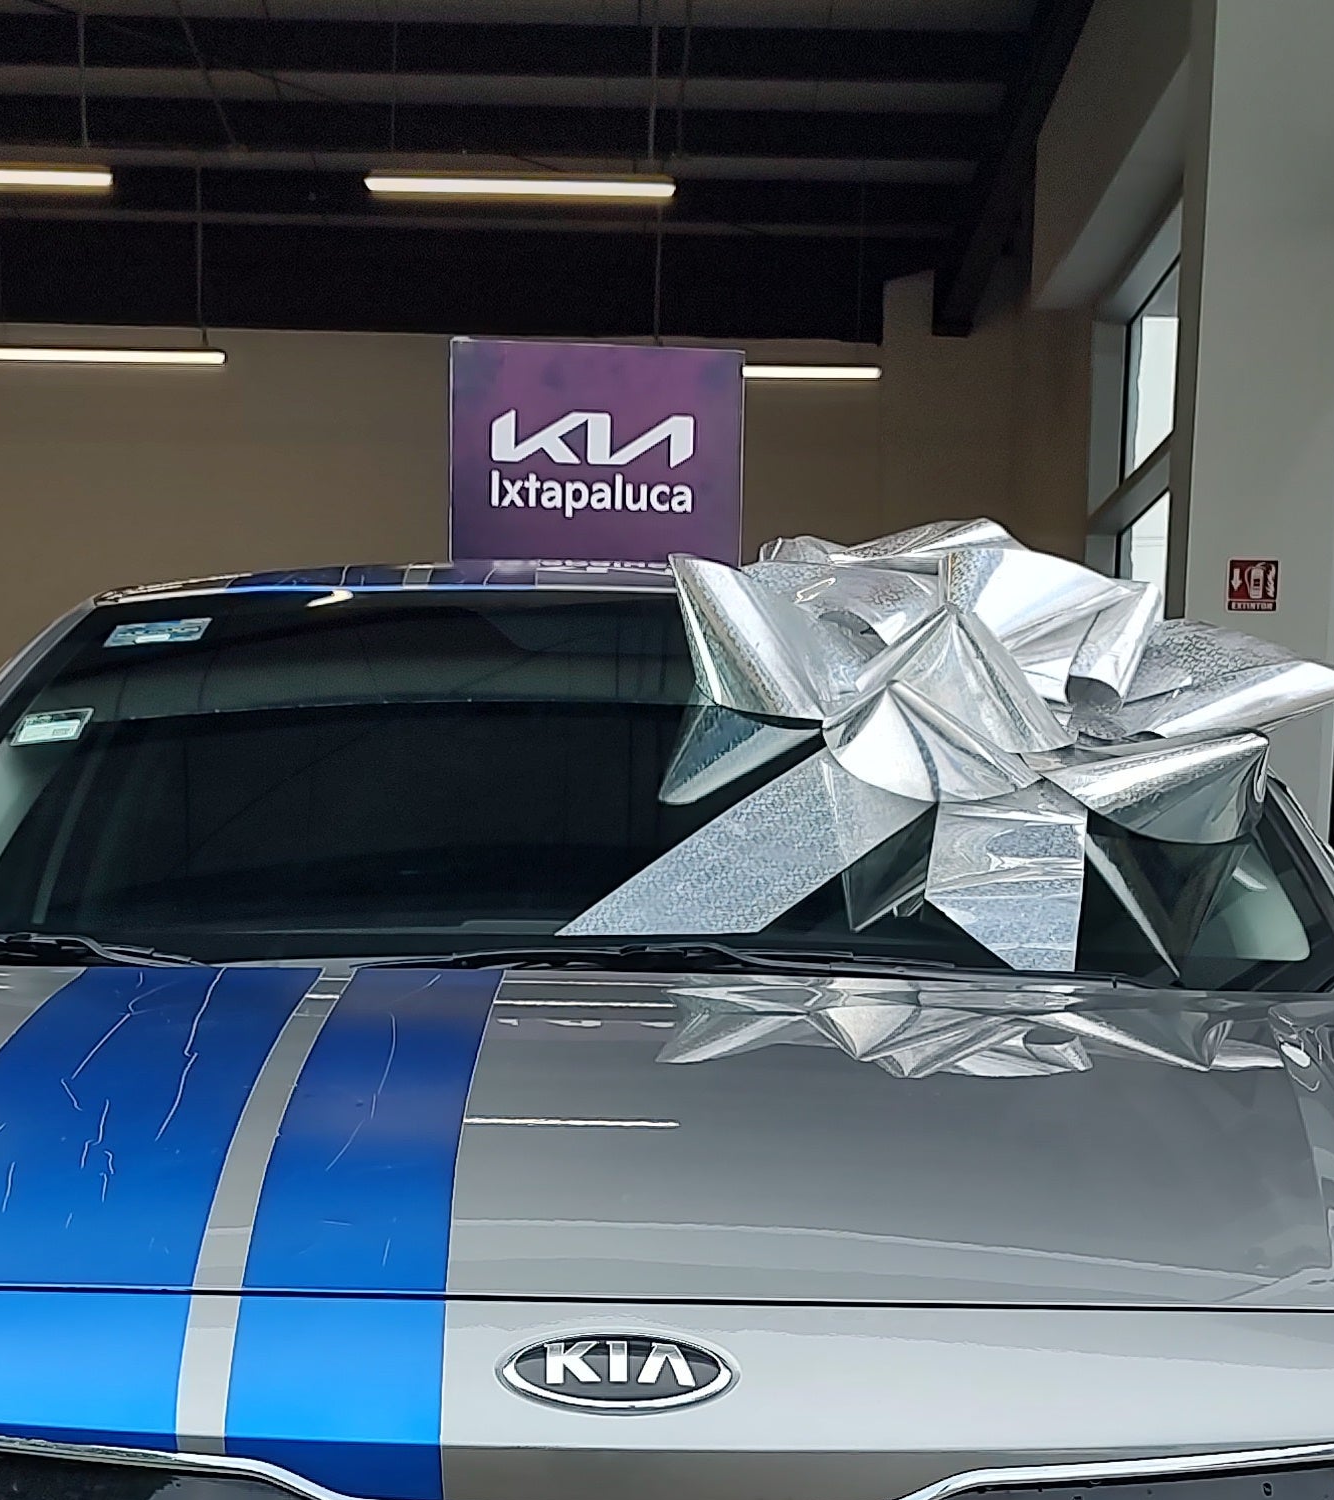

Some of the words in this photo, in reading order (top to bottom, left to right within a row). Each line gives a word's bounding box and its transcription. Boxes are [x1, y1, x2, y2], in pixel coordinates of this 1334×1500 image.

[490, 408, 695, 469] KIA
[489, 468, 693, 518] Ixtapaluca
[1231, 602, 1274, 610] EXTINTOR
[543, 1340, 696, 1388] KIA
